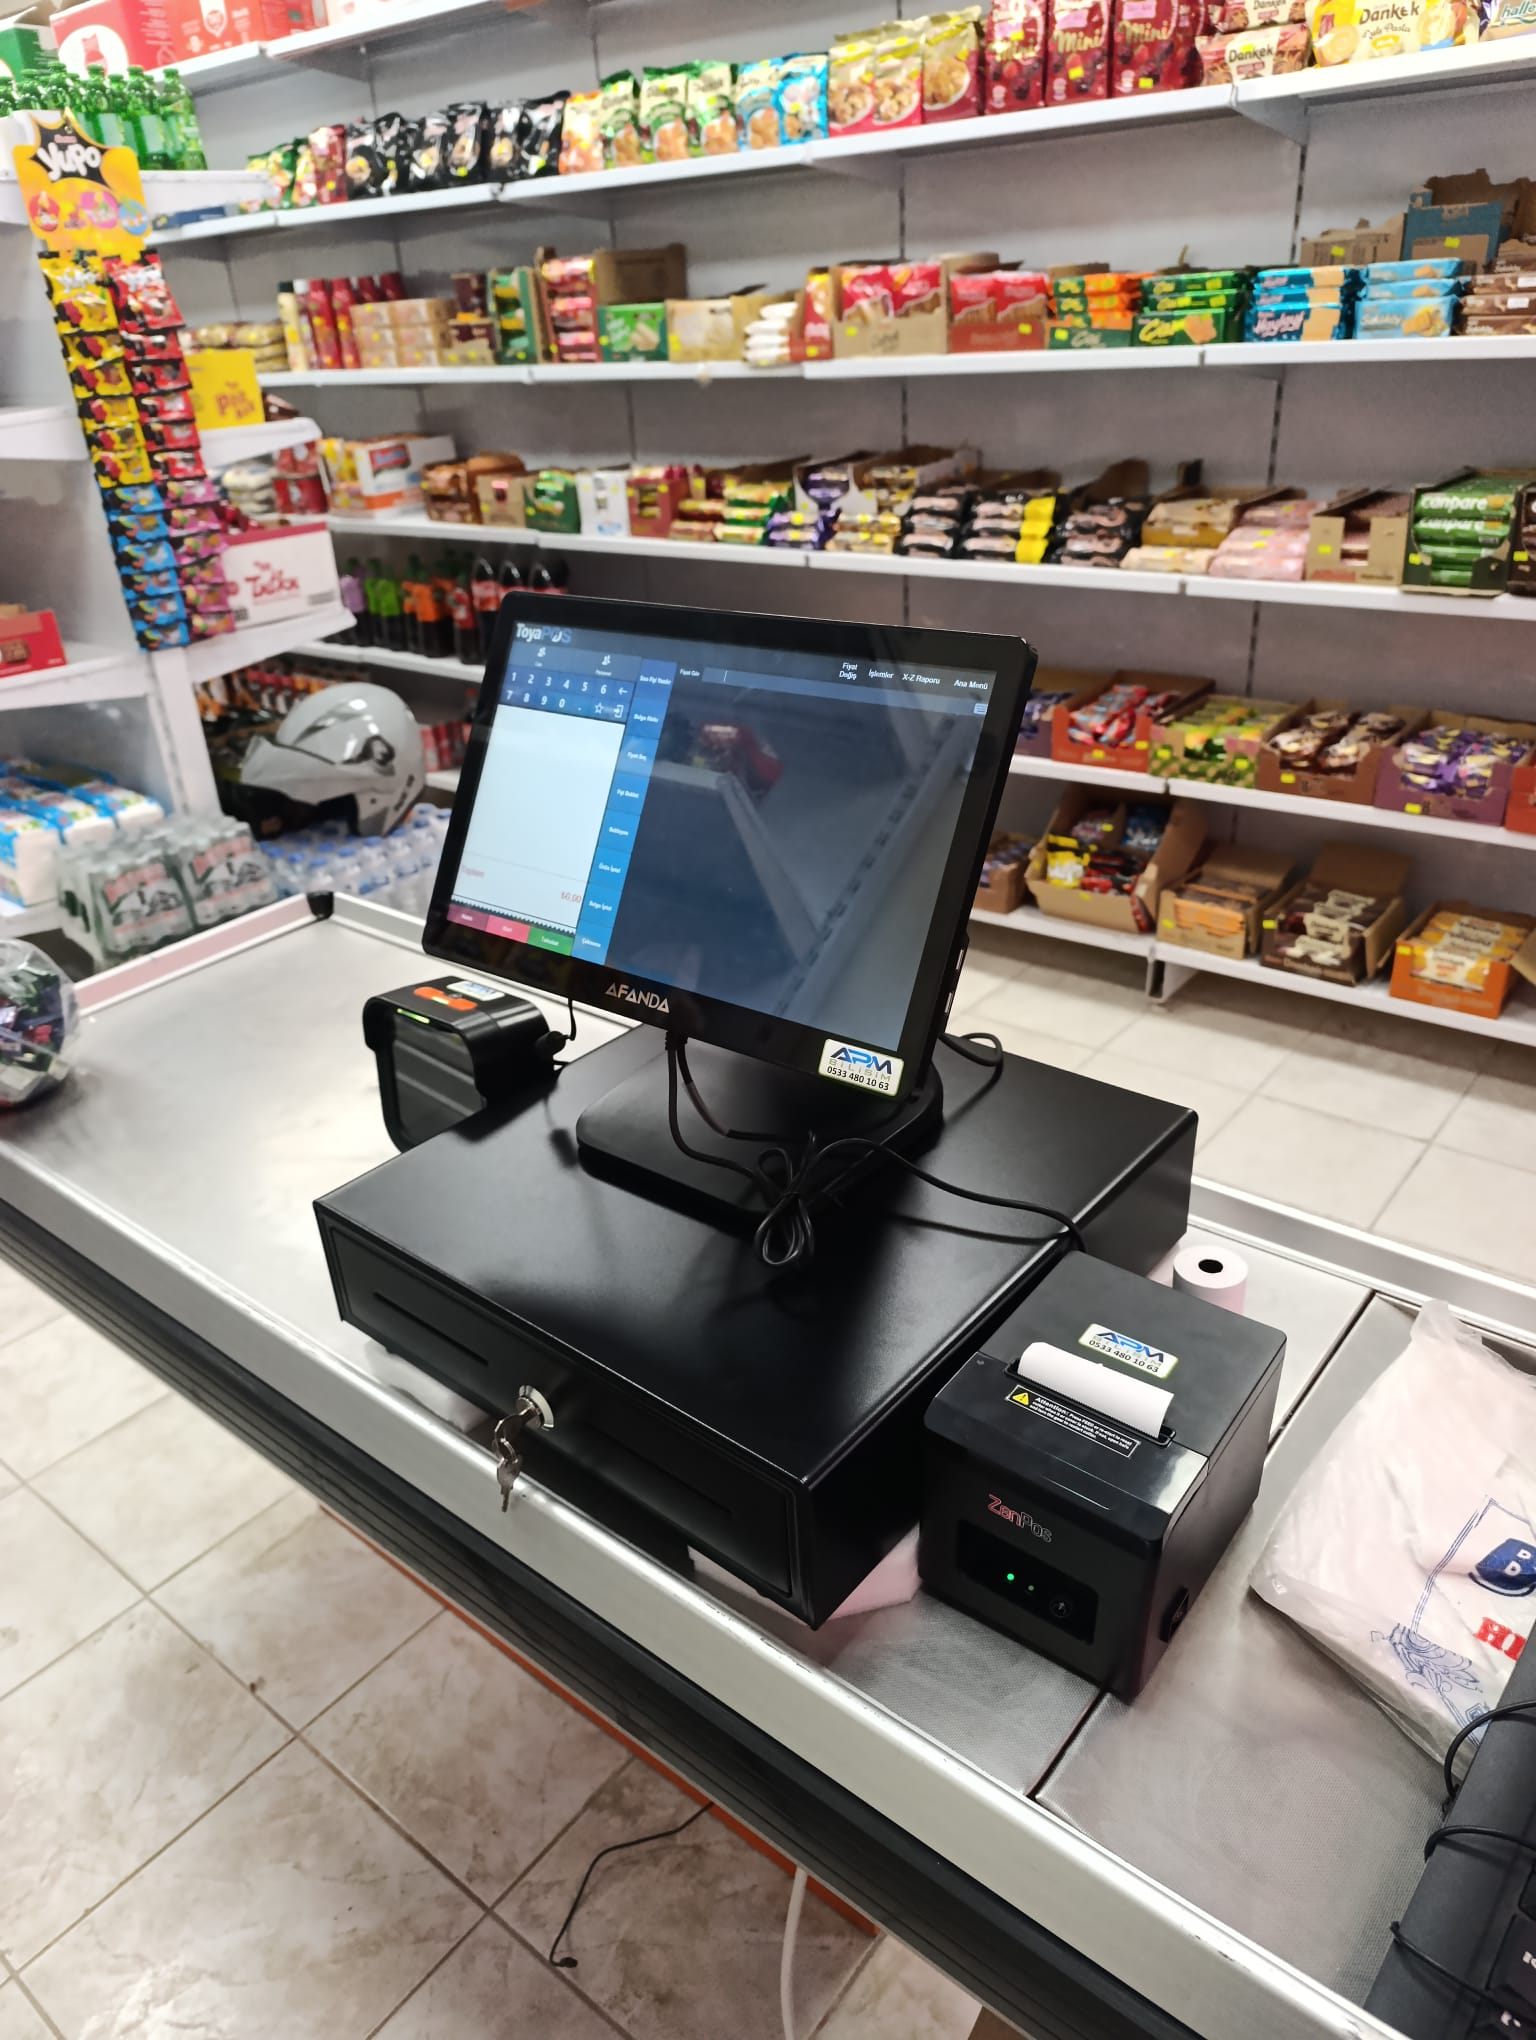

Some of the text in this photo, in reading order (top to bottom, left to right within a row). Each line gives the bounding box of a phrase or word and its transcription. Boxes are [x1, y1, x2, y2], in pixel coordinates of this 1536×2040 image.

[1359, 2, 1421, 25] Dankek
[1229, 43, 1274, 63] Dankek
[511, 672, 608, 695] 1 2 3 4 5 6
[901, 673, 916, 681] X-Z
[953, 678, 989, 690] Ana Menü
[506, 689, 566, 709] 7 8 9 0
[605, 981, 670, 1014] AFANDA
[830, 1047, 893, 1075] APM
[827, 1065, 889, 1091] 0533 480 10 63
[1089, 1340, 1159, 1374] 0533 480 10 63
[1096, 1332, 1164, 1363] APM
[987, 1493, 1053, 1543] ZenPos
